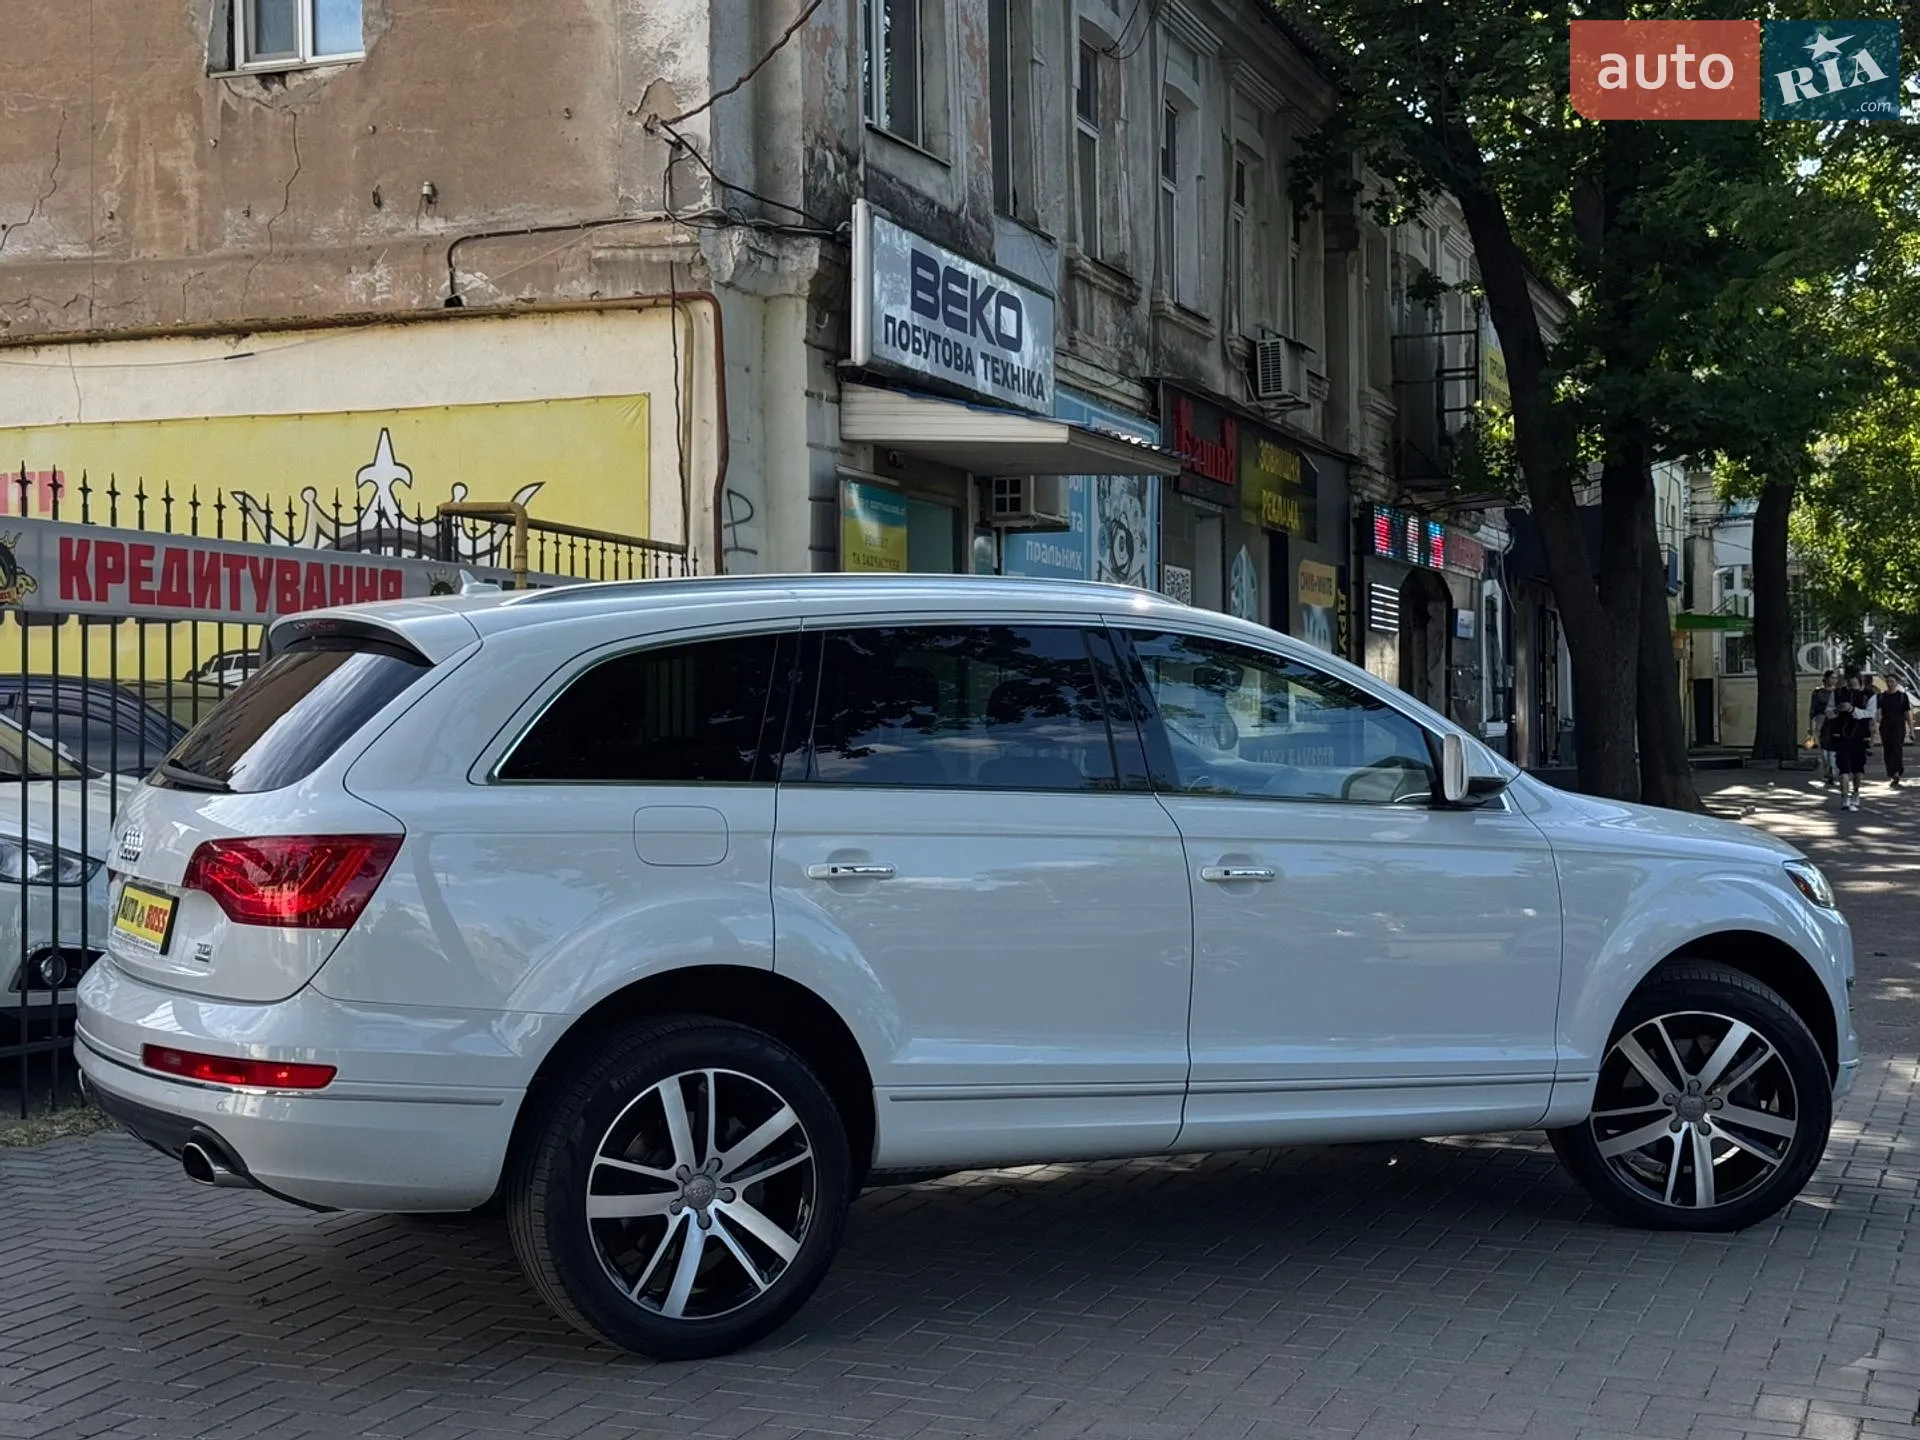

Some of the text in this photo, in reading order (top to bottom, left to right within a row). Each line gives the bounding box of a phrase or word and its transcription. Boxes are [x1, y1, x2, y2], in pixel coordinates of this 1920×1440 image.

[911, 248, 1022, 353] BEKO
[884, 314, 1046, 402] ПОБУТОВА ТЕХНІКА
[59, 536, 403, 615] КРЕДИТУВАННЯ
[1026, 540, 1082, 571] пральних
[145, 904, 168, 934] BOSS
